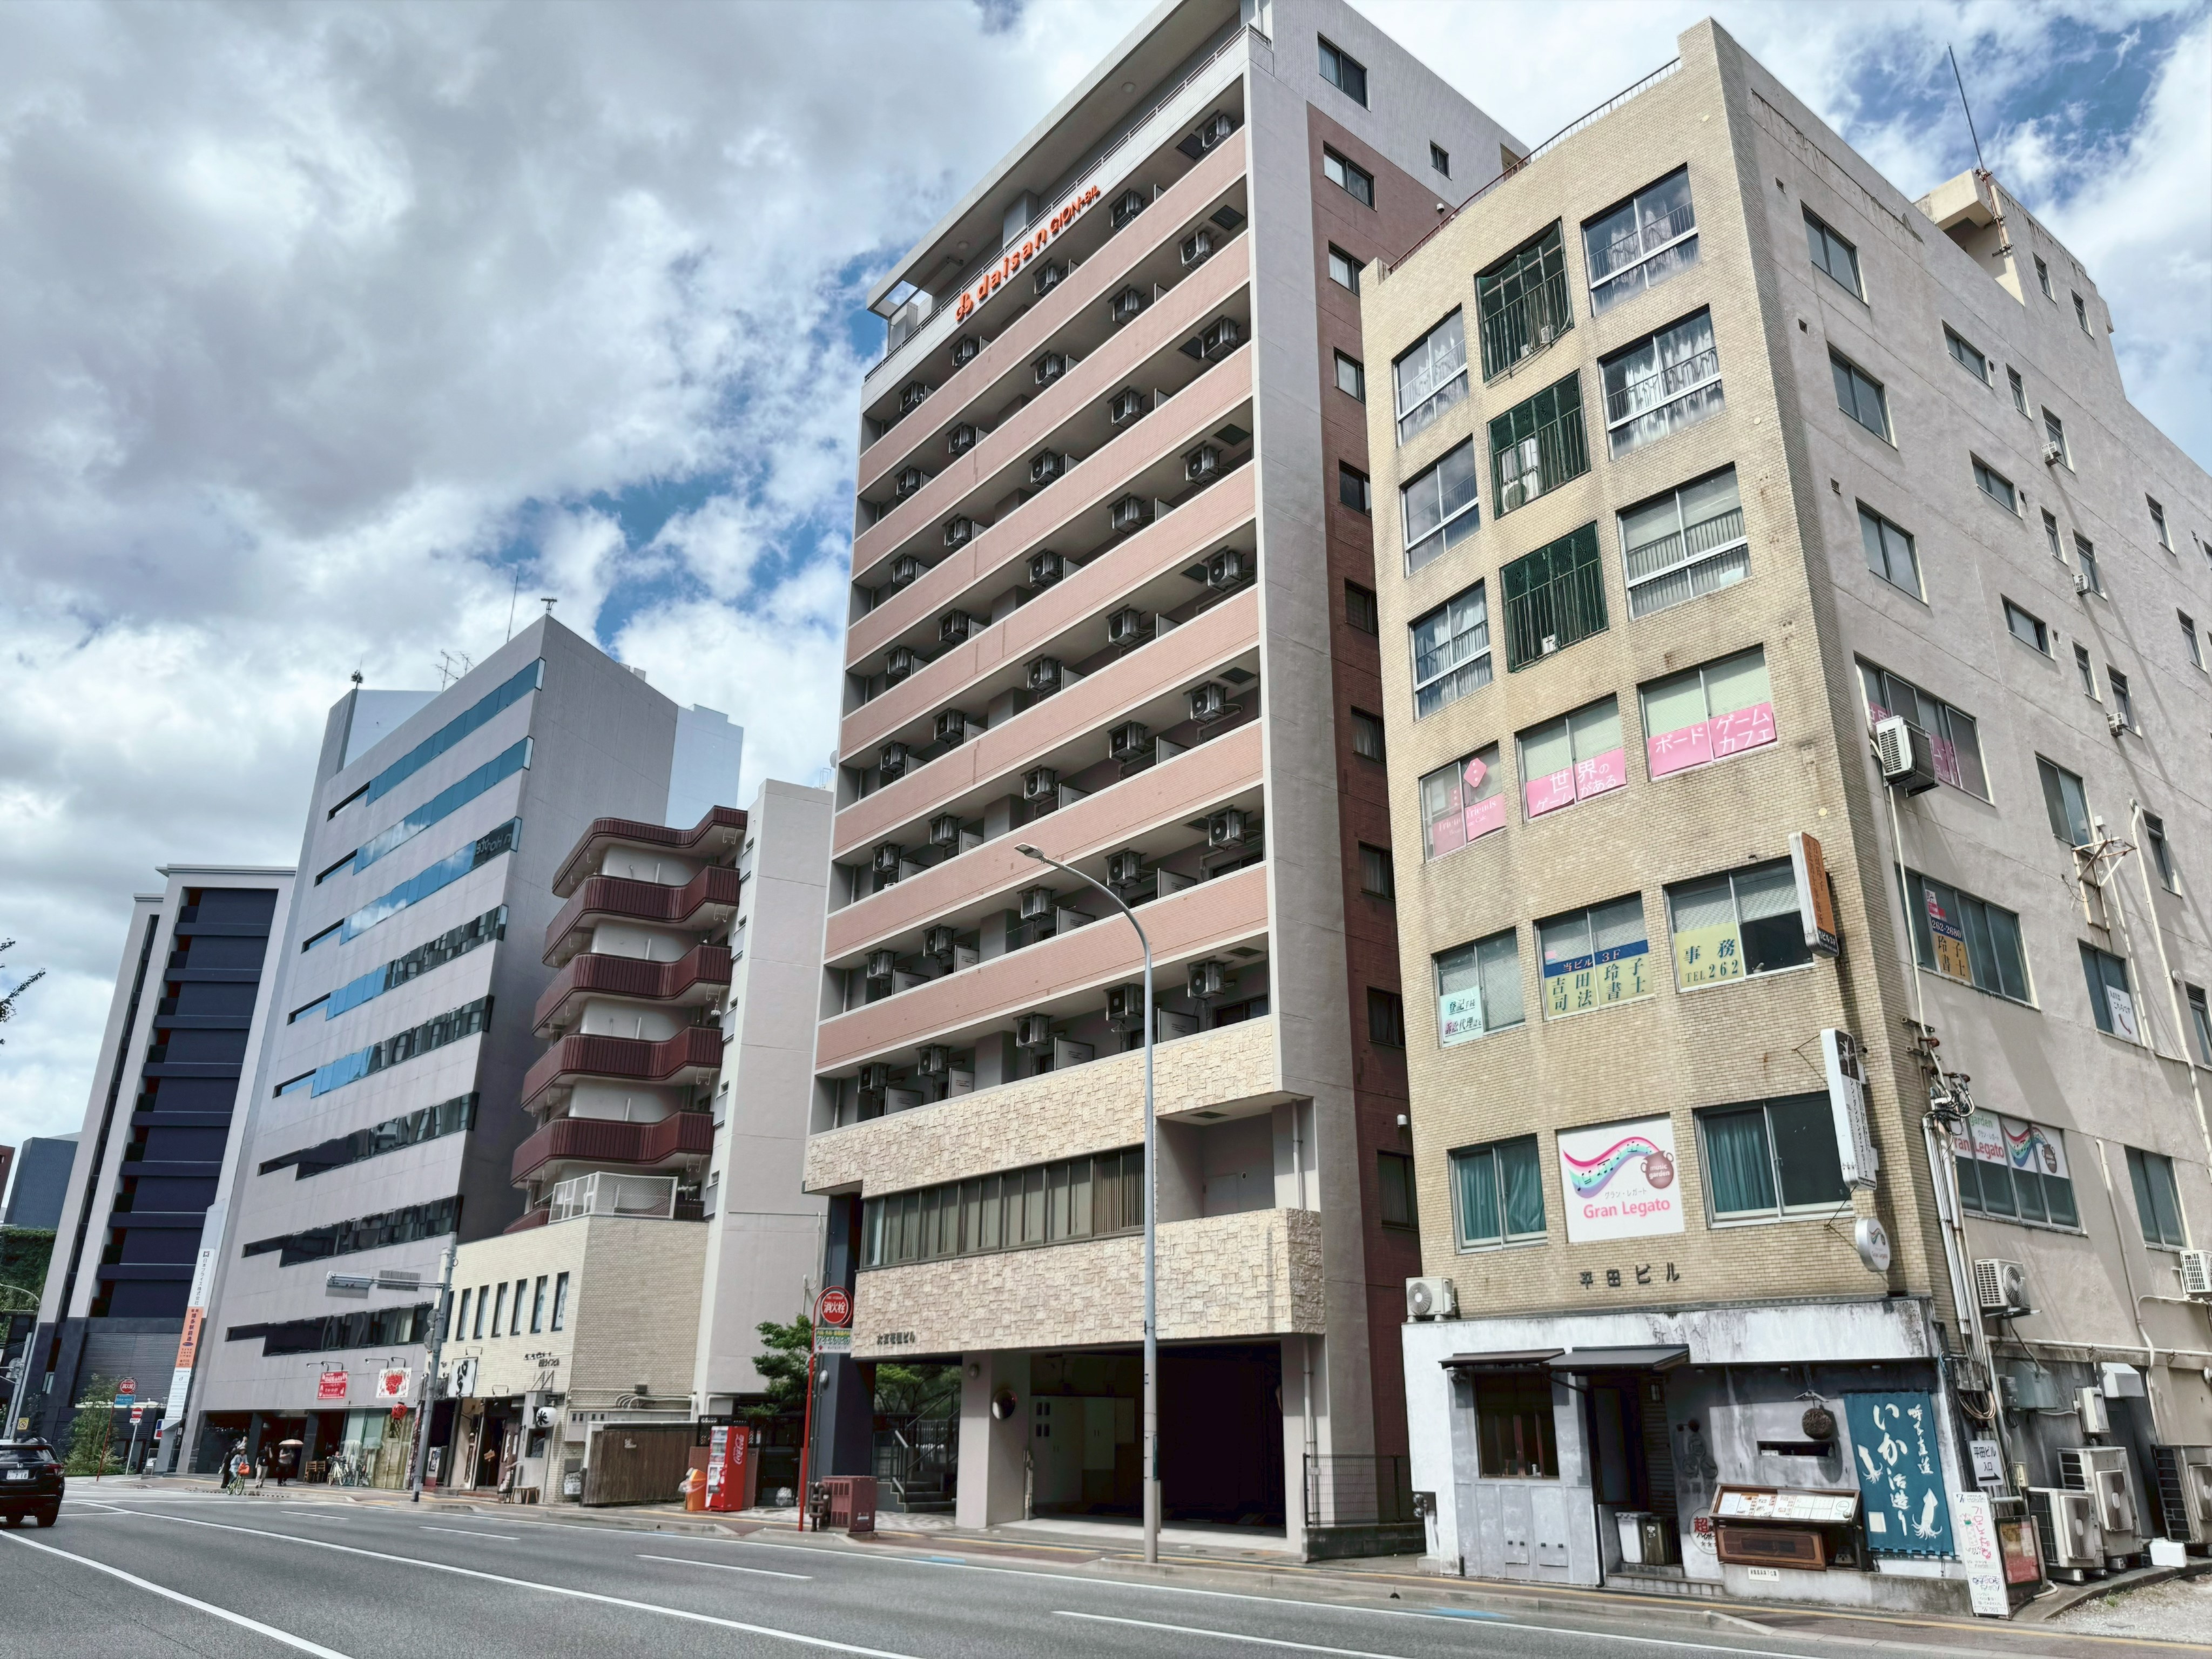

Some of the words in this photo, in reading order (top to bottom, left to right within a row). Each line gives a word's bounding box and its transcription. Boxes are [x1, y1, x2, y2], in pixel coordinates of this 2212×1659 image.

[976, 228, 1047, 300] daisan
[1050, 185, 1101, 234] GION-BIL
[1656, 726, 1704, 754] ボード
[1716, 708, 1770, 735] ゲーム
[1719, 728, 1772, 754] カフェ
[1549, 759, 1609, 794] 世界の
[1536, 774, 1616, 811] ゲームがある
[1466, 799, 1497, 819] Friends
[1932, 919, 1962, 939] 262-2680
[1562, 958, 1593, 973] 当ビル
[1601, 948, 1620, 962] 3F
[1683, 939, 1735, 964] 事務
[1551, 957, 1644, 995] 吉田玲子
[1685, 970, 1705, 982] TEL
[1708, 959, 1738, 979] 262
[1554, 976, 1646, 1011] 司法書士
[1968, 1114, 1993, 1129] garden
[1954, 1137, 1971, 1152] ran
[1973, 1136, 2005, 1159] Legato
[1649, 1171, 1670, 1180] garden
[1604, 1188, 1647, 1199] グラン・レガート
[1583, 1204, 1617, 1219] Gran
[1622, 1198, 1670, 1217] Legato
[1580, 1262, 1680, 1290] 平田ビル
[823, 1301, 846, 1313] 消火栓
[537, 1410, 549, 1426] 米
[733, 1433, 745, 1465] Coca-Cola
[1973, 1446, 1997, 1459] 平田ビル
[1984, 1461, 1994, 1472] 入口
